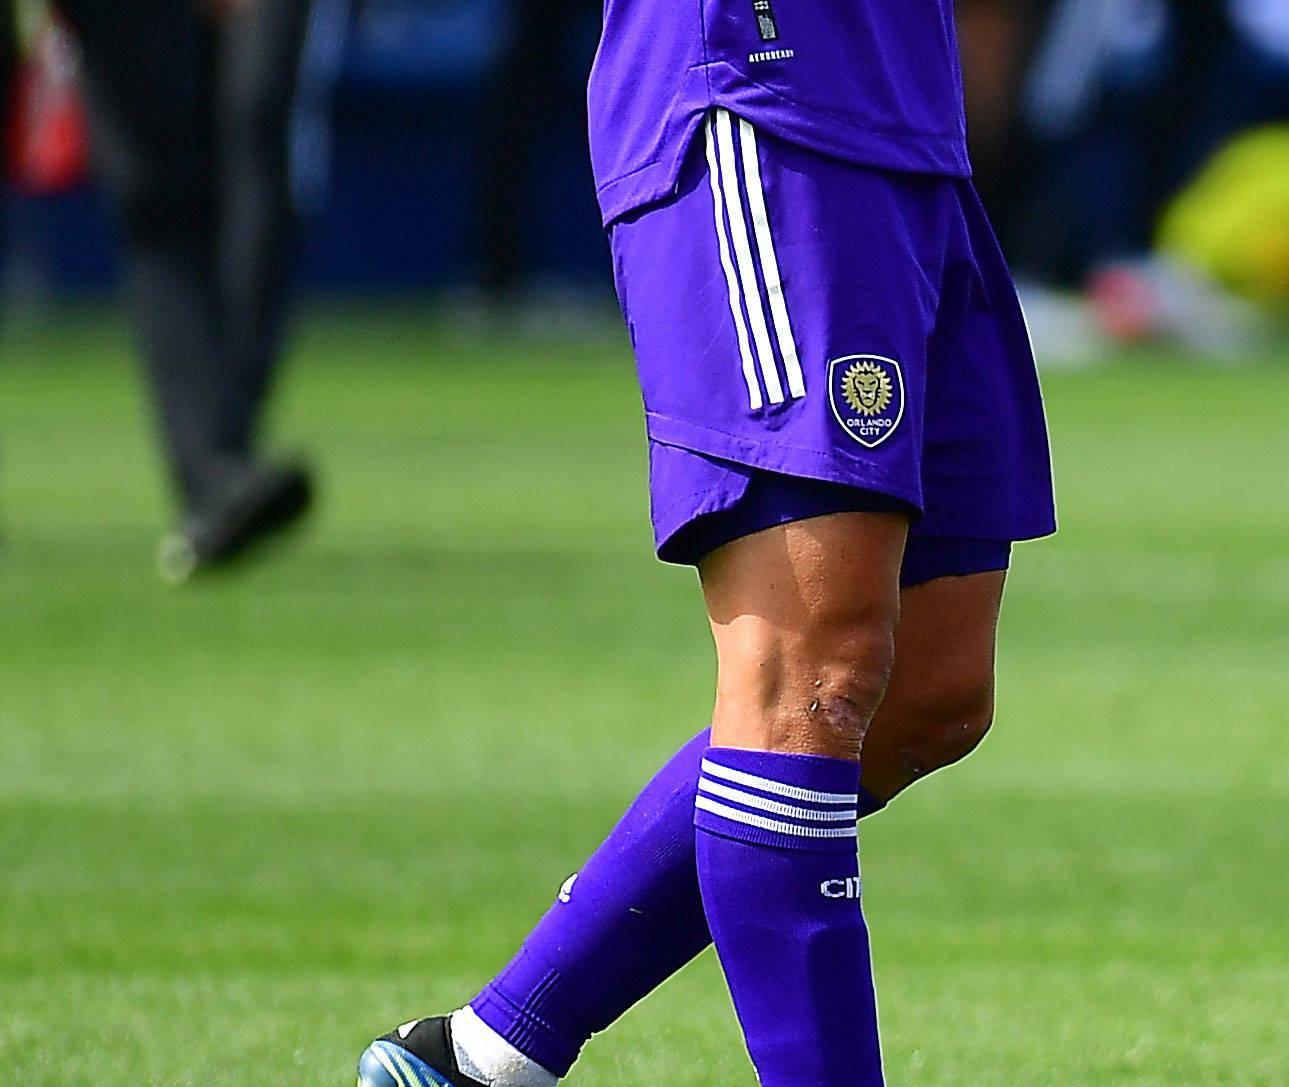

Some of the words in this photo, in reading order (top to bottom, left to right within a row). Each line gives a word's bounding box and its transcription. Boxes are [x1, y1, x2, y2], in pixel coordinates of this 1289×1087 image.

[846, 418, 893, 427] ORLANDO
[859, 427, 881, 436] CITY
[820, 876, 861, 899] CIT
